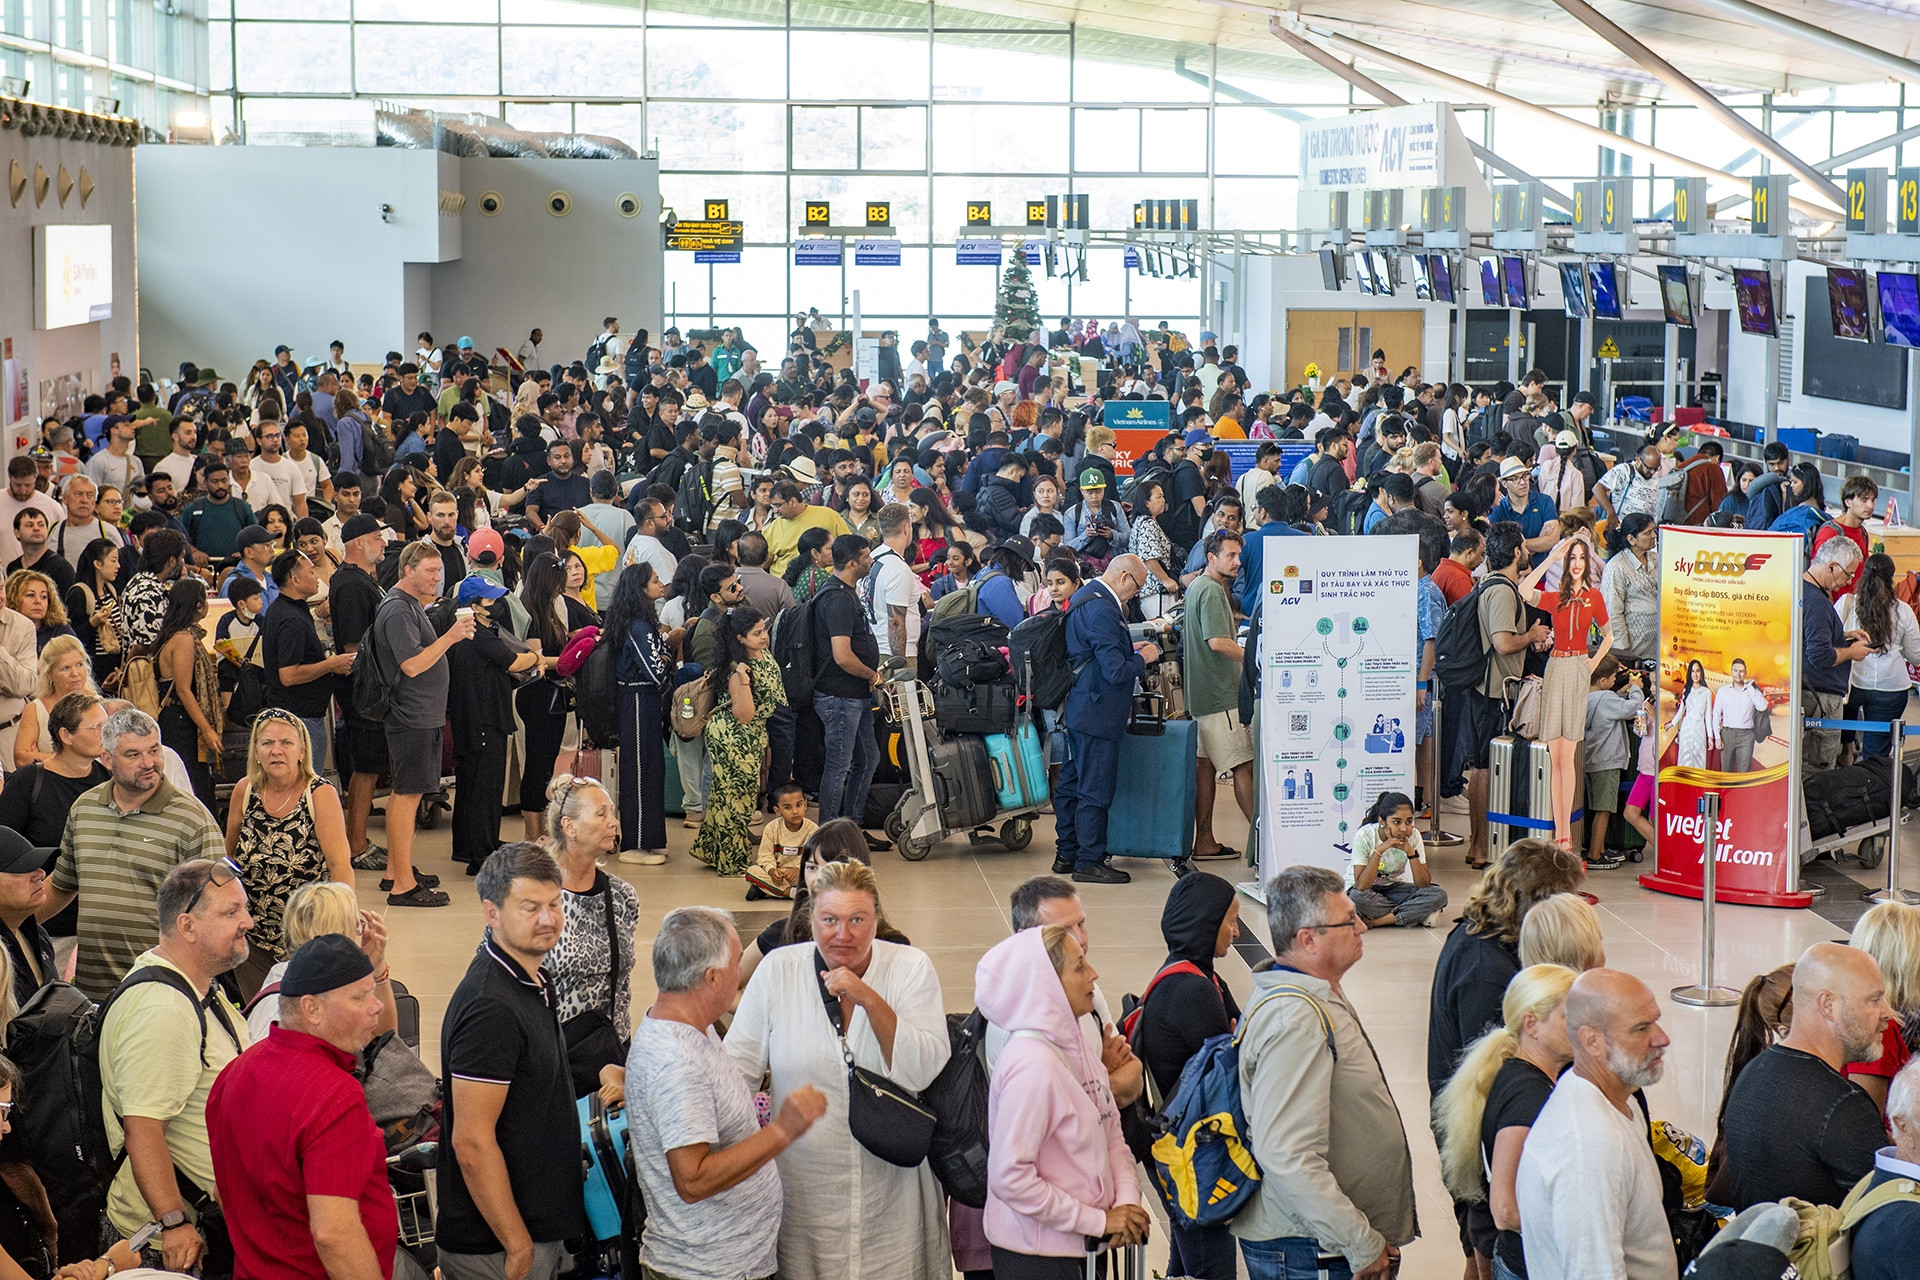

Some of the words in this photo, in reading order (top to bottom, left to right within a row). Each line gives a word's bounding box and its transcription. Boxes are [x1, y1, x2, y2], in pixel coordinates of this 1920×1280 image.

[1380, 126, 1407, 172] ACV
[707, 203, 726, 219] B1
[807, 206, 828, 221] B2
[868, 206, 888, 221] B3
[968, 206, 990, 220] B4
[1331, 199, 1335, 222] 1
[1384, 196, 1389, 222] 3
[1423, 197, 1428, 223] 4
[1444, 195, 1450, 223] 5
[1494, 193, 1500, 222] 6
[1519, 192, 1526, 222] 7
[1575, 190, 1582, 224] 8
[1606, 189, 1614, 224] 9
[1674, 189, 1687, 222] 10
[1754, 188, 1767, 223] 11
[1848, 181, 1865, 220] 12
[1900, 180, 1917, 221] 13
[1115, 451, 1131, 459] KY
[1281, 597, 1301, 605] ACV
[1674, 587, 1683, 596] Bay
[1684, 587, 1697, 598] đẳng
[1699, 590, 1709, 598] cấp
[1711, 590, 1730, 600] BOSS,
